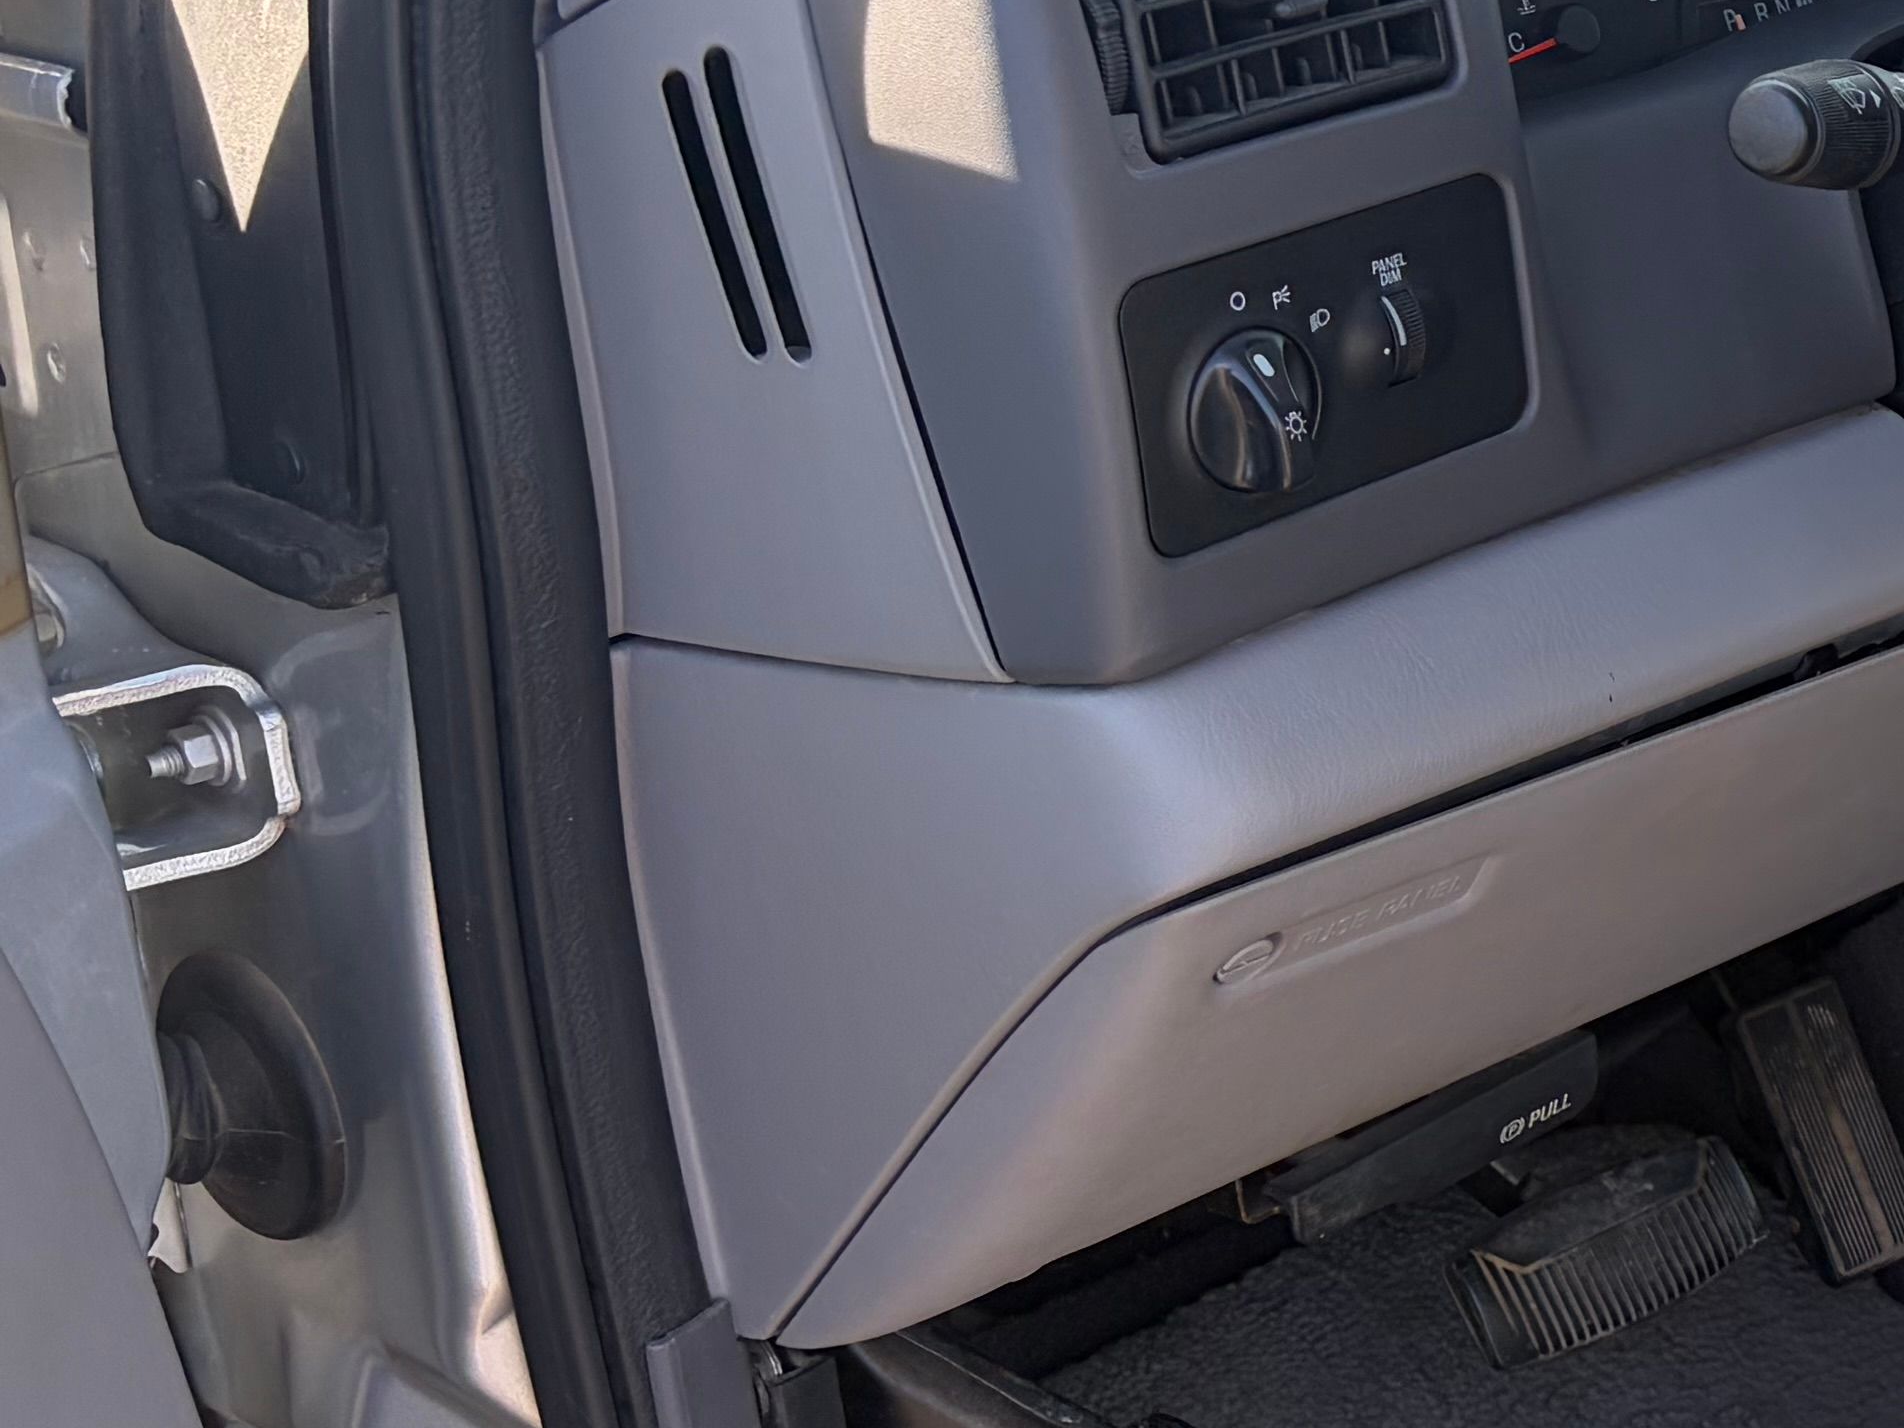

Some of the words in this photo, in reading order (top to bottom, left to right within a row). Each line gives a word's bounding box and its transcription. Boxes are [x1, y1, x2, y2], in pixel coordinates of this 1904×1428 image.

[1753, 2, 1769, 22] R
[1507, 31, 1525, 53] C
[1371, 252, 1407, 275] PANEL
[1378, 269, 1402, 287] DIM
[1528, 1093, 1572, 1128] PULL
